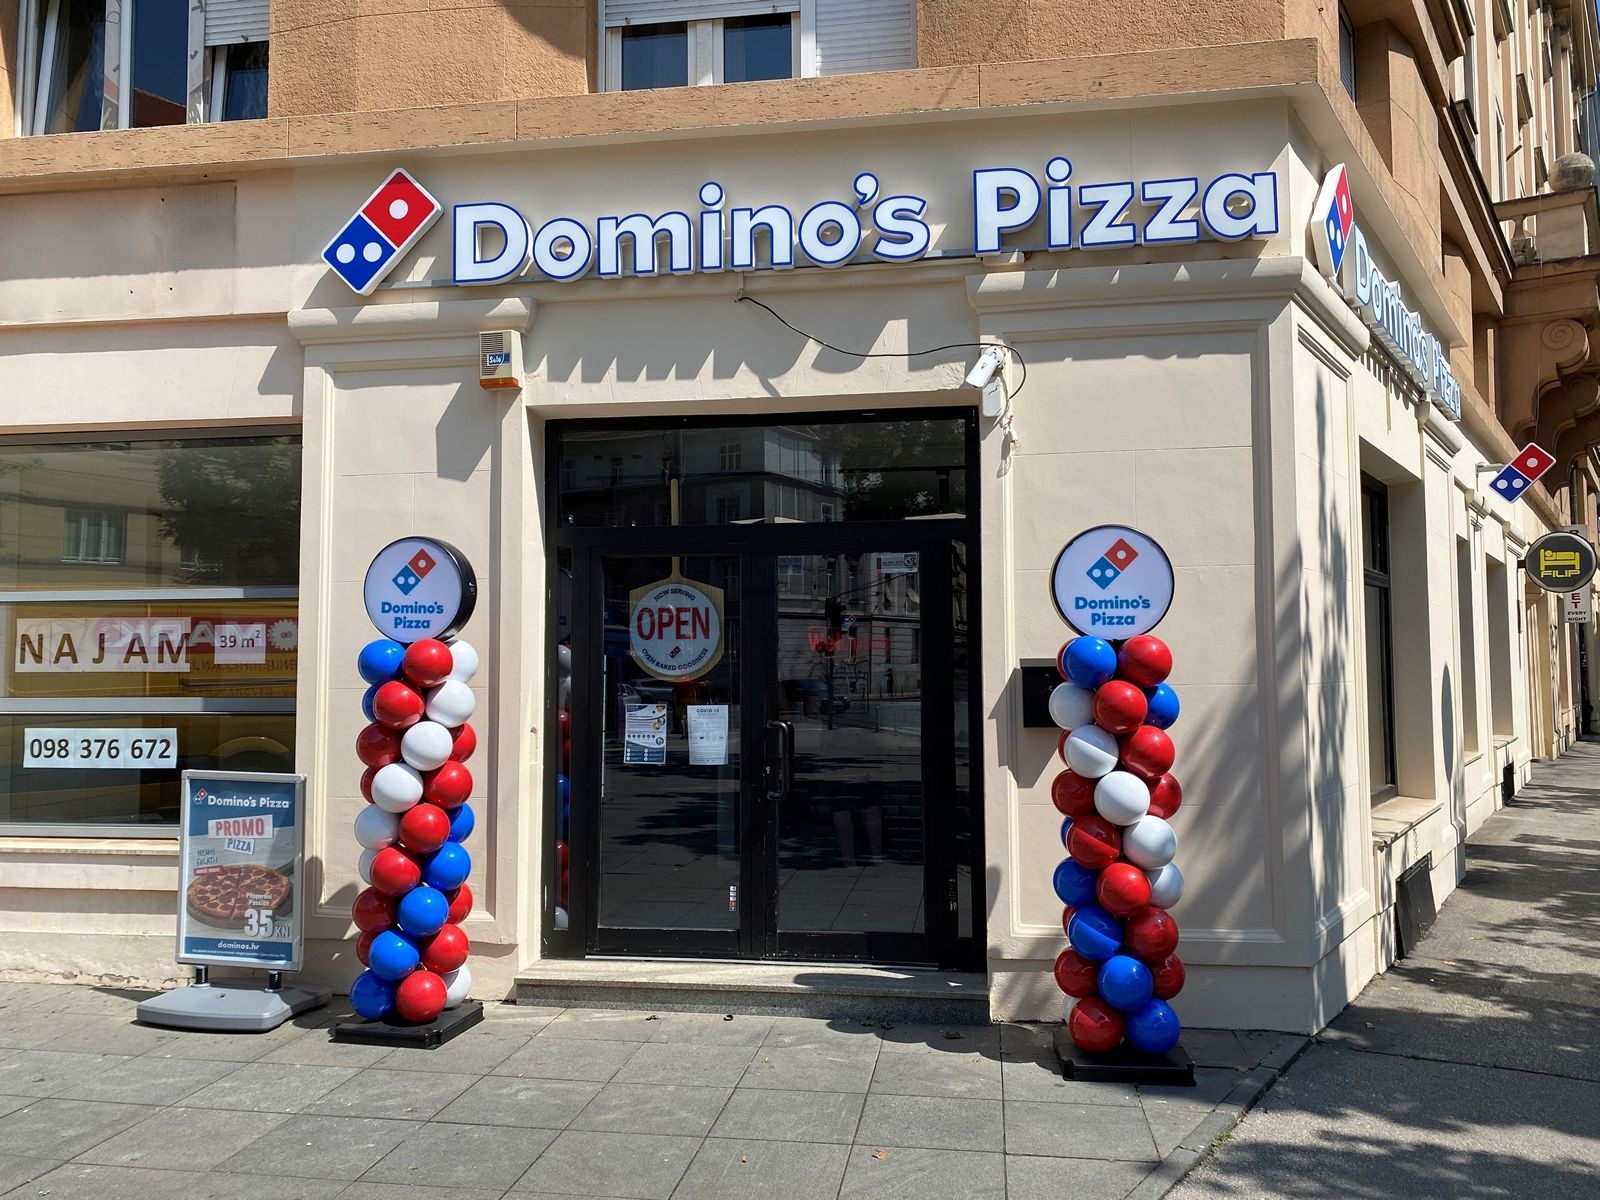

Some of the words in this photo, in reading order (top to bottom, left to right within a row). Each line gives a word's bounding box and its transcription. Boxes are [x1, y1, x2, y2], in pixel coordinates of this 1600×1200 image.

[452, 172, 931, 284] Domino's
[973, 156, 1279, 253] Pizza
[1540, 569, 1581, 578] FILIP
[653, 588, 670, 602] NOW
[670, 587, 696, 601] SERVING
[381, 601, 444, 614] Domino's
[1074, 595, 1151, 610] Domino's
[393, 616, 431, 629] Pizza
[636, 606, 710, 641] OPEN
[1091, 612, 1136, 626] Pizza
[19, 632, 191, 665] NAJAM
[219, 635, 237, 649] 39
[641, 648, 656, 665] OVEN
[655, 661, 677, 671] BAKED
[677, 647, 709, 671] GOODNESS
[29, 738, 70, 759] 098
[80, 738, 120, 759] 376
[131, 738, 171, 759] 672
[207, 795, 257, 808] Domino's
[259, 797, 290, 809] Pizza
[215, 817, 265, 837] PROMO
[227, 838, 251, 853] PIZZA
[244, 908, 274, 938] 35
[275, 927, 290, 938] KN
[217, 941, 260, 951] dominos.hr
